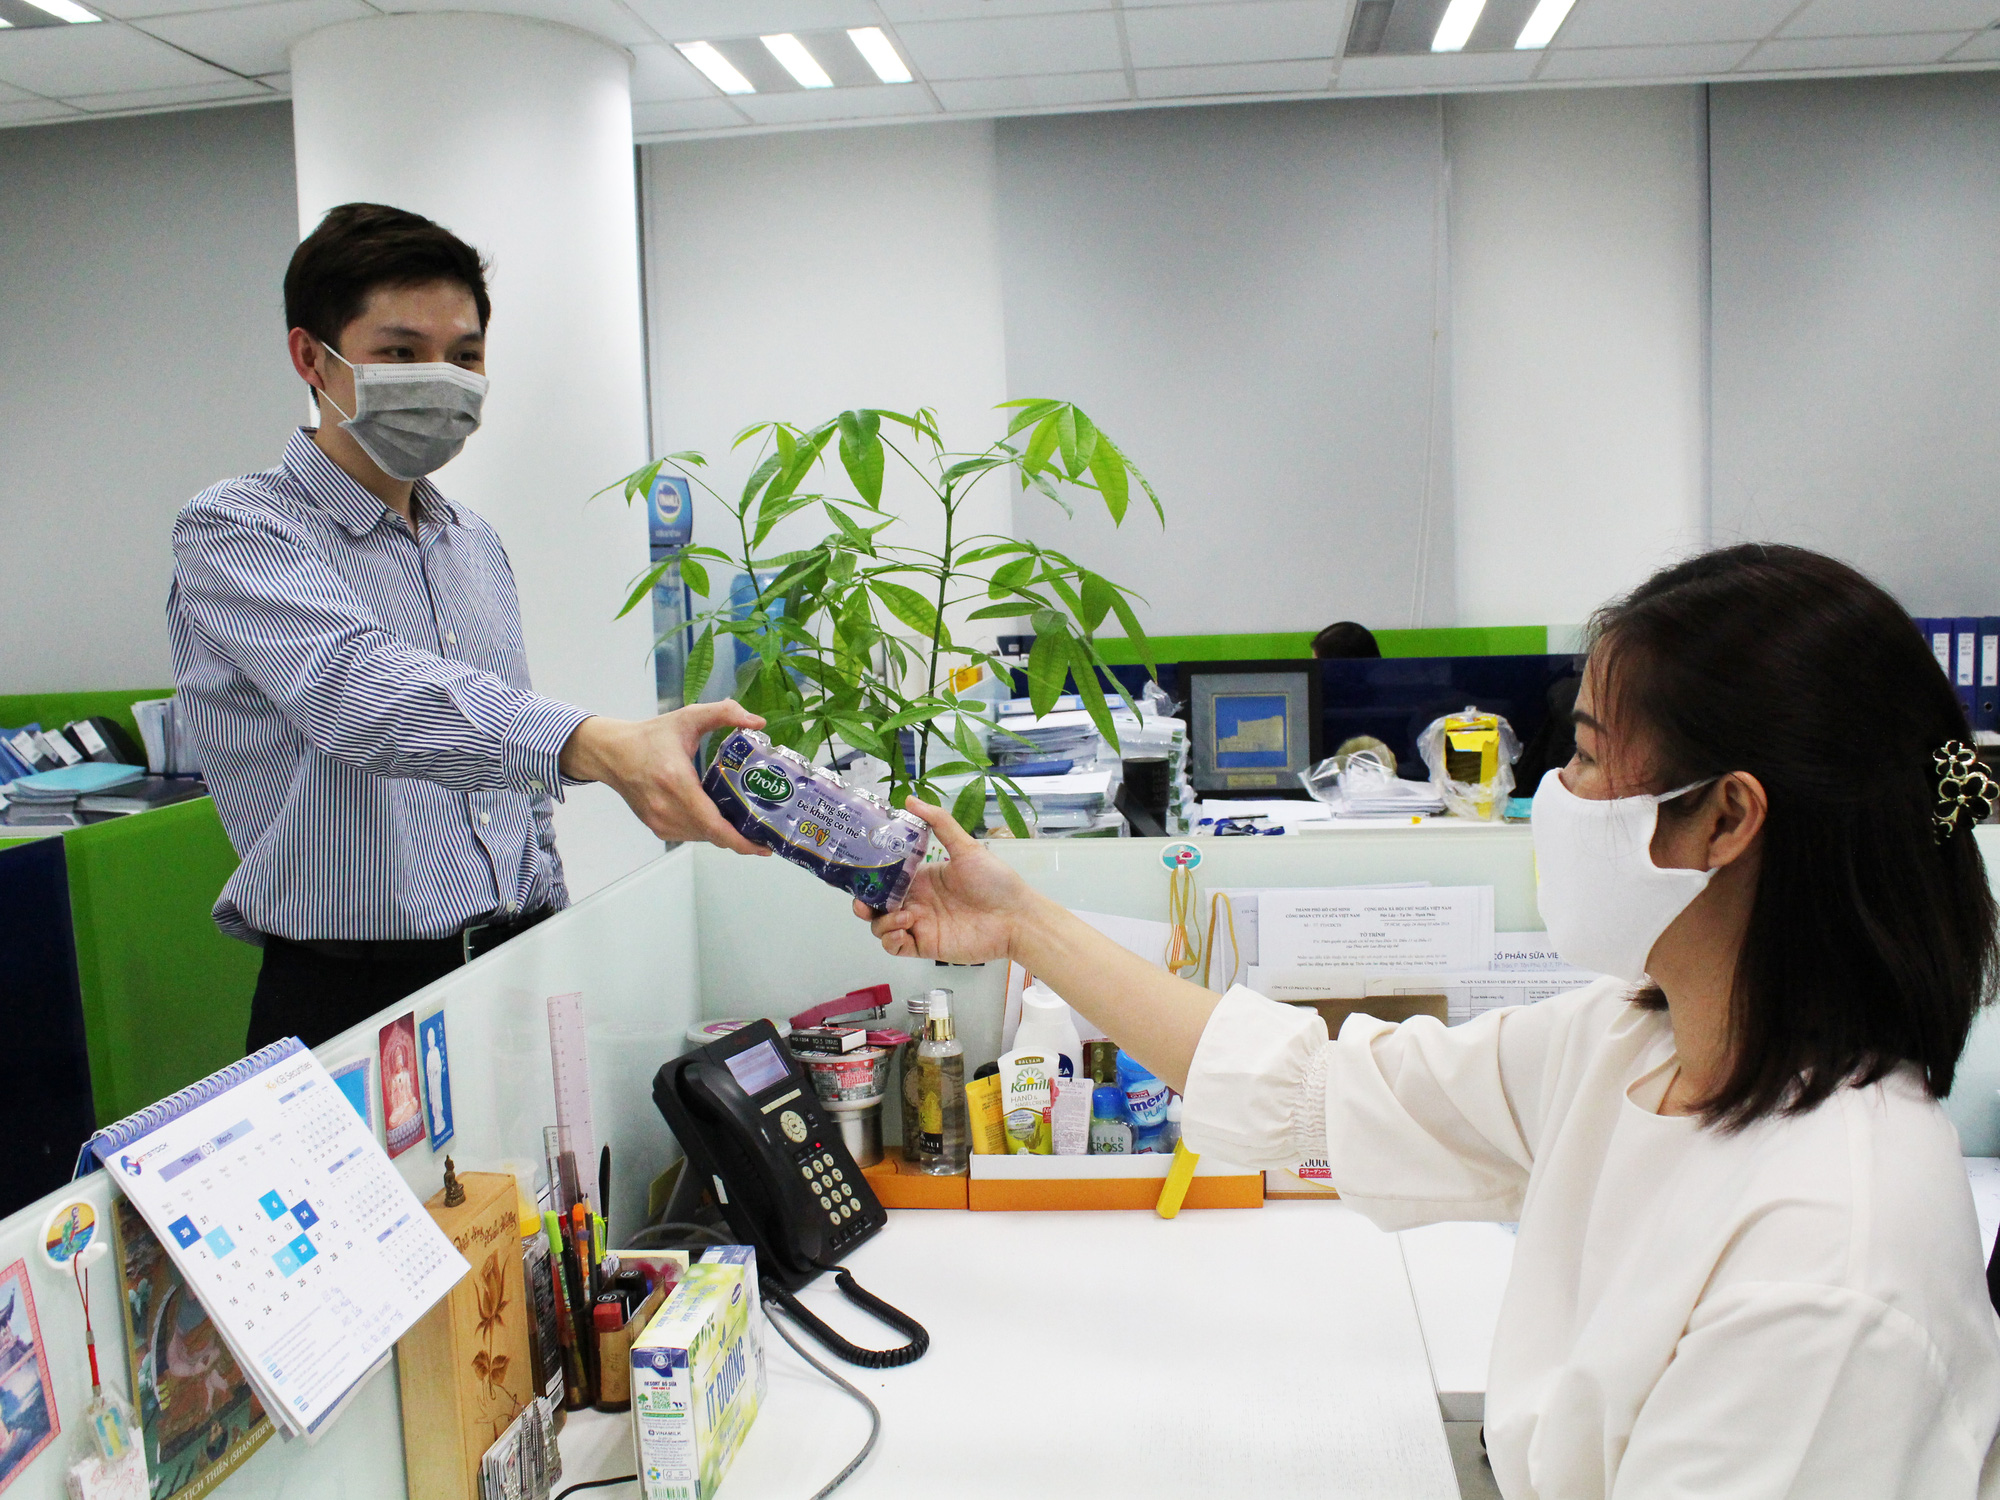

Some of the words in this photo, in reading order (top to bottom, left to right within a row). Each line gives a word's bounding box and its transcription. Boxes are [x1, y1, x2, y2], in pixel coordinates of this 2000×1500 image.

[799, 821, 819, 837] 65
[816, 828, 831, 846] tỷ
[1529, 951, 1544, 960] SỮA
[275, 1075, 287, 1086] KB
[284, 1062, 313, 1080] Securities
[1011, 1078, 1050, 1094] Kamill
[1010, 1094, 1033, 1103] HAND
[181, 1152, 201, 1166] Tháng
[201, 1142, 216, 1155] 03
[216, 1132, 234, 1145] March
[179, 1227, 191, 1239] 30
[200, 1215, 209, 1225] 31
[200, 1250, 207, 1259] 2
[255, 1213, 261, 1221] 5
[271, 1200, 278, 1209] 6
[288, 1189, 294, 1197] 7
[232, 1260, 241, 1269] 10
[250, 1247, 259, 1256] 11
[267, 1234, 276, 1244] 12
[284, 1222, 293, 1231] 13
[300, 1210, 310, 1220] 14
[316, 1199, 325, 1208] 15
[229, 1296, 239, 1306] 16
[247, 1283, 256, 1292] 17
[265, 1269, 274, 1278] 18
[314, 1232, 324, 1241] 21
[330, 1220, 339, 1229] 22
[244, 1319, 255, 1330] 23
[263, 1305, 272, 1315] 24
[281, 1291, 290, 1301] 25
[297, 1278, 307, 1287] 26
[314, 1264, 323, 1274] 27
[330, 1252, 339, 1262] 28
[345, 1240, 353, 1250] 29
